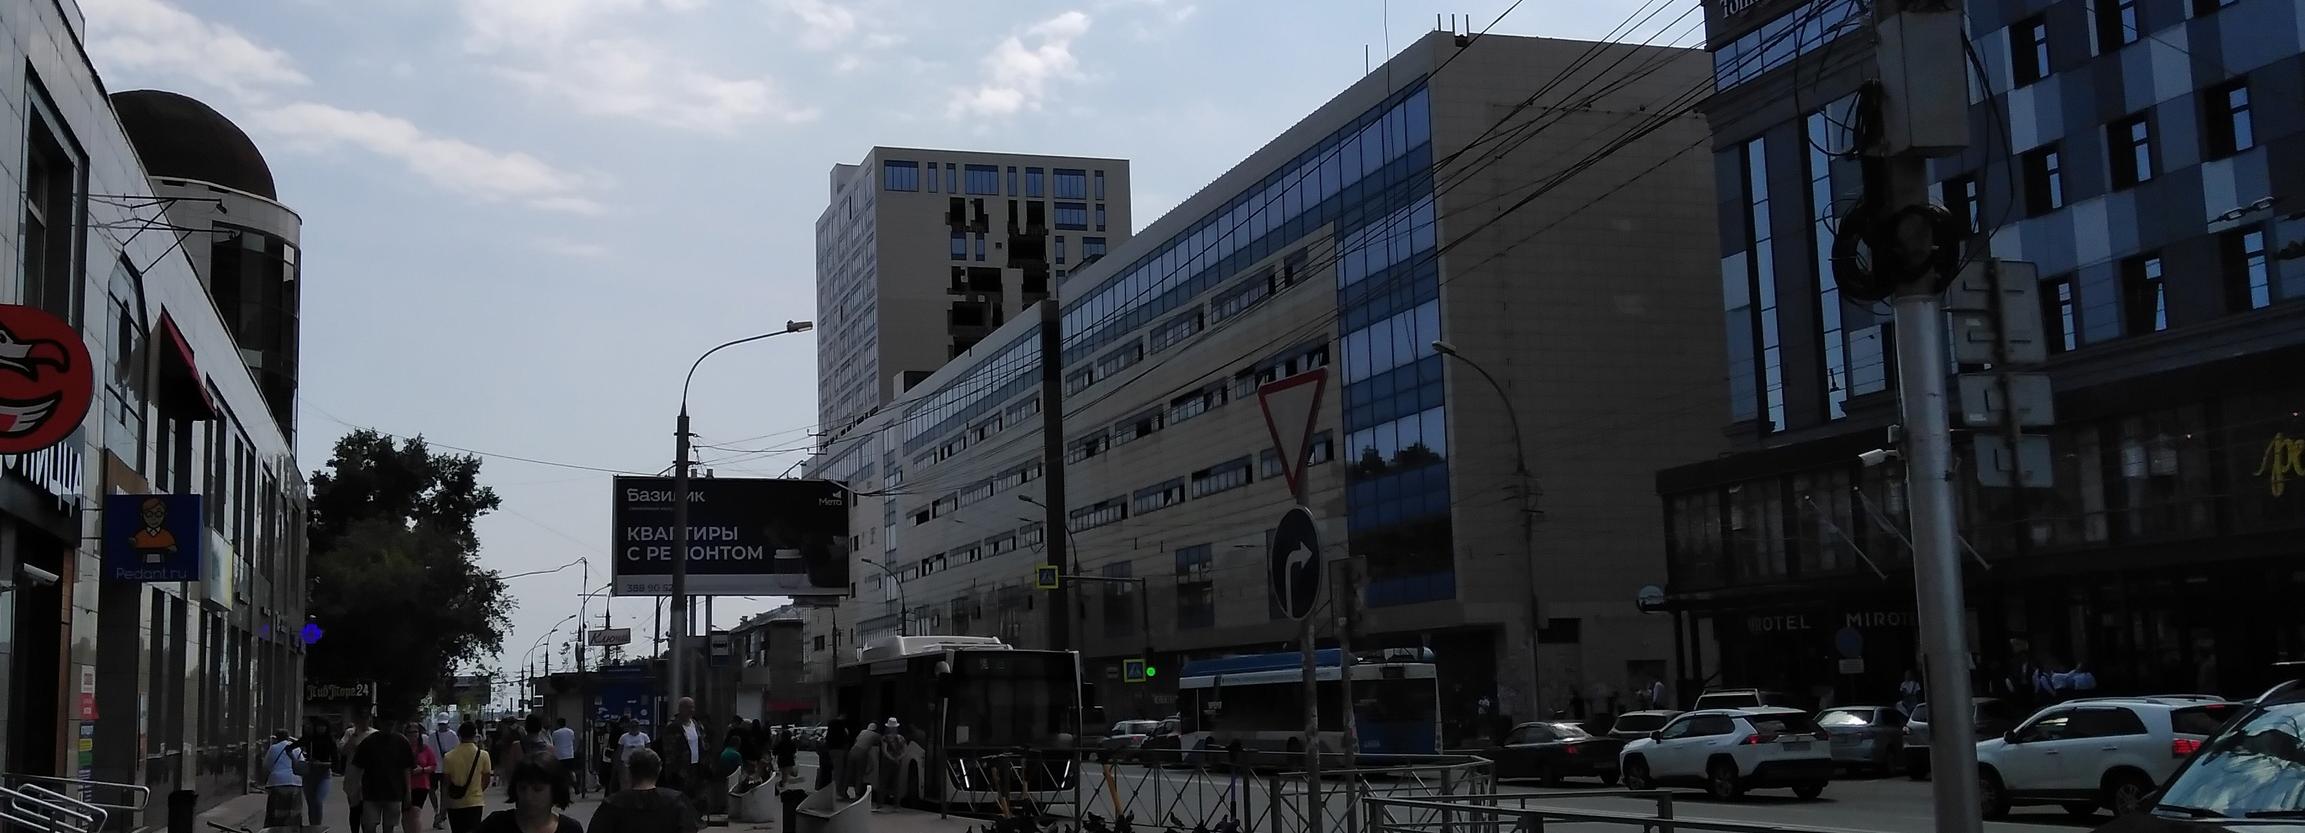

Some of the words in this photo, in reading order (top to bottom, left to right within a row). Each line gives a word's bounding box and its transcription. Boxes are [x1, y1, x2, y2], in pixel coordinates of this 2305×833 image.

[626, 487, 706, 503] Базиик
[818, 497, 843, 507] Мета
[627, 546, 641, 561] С
[647, 545, 764, 561] РЕОНТОМ
